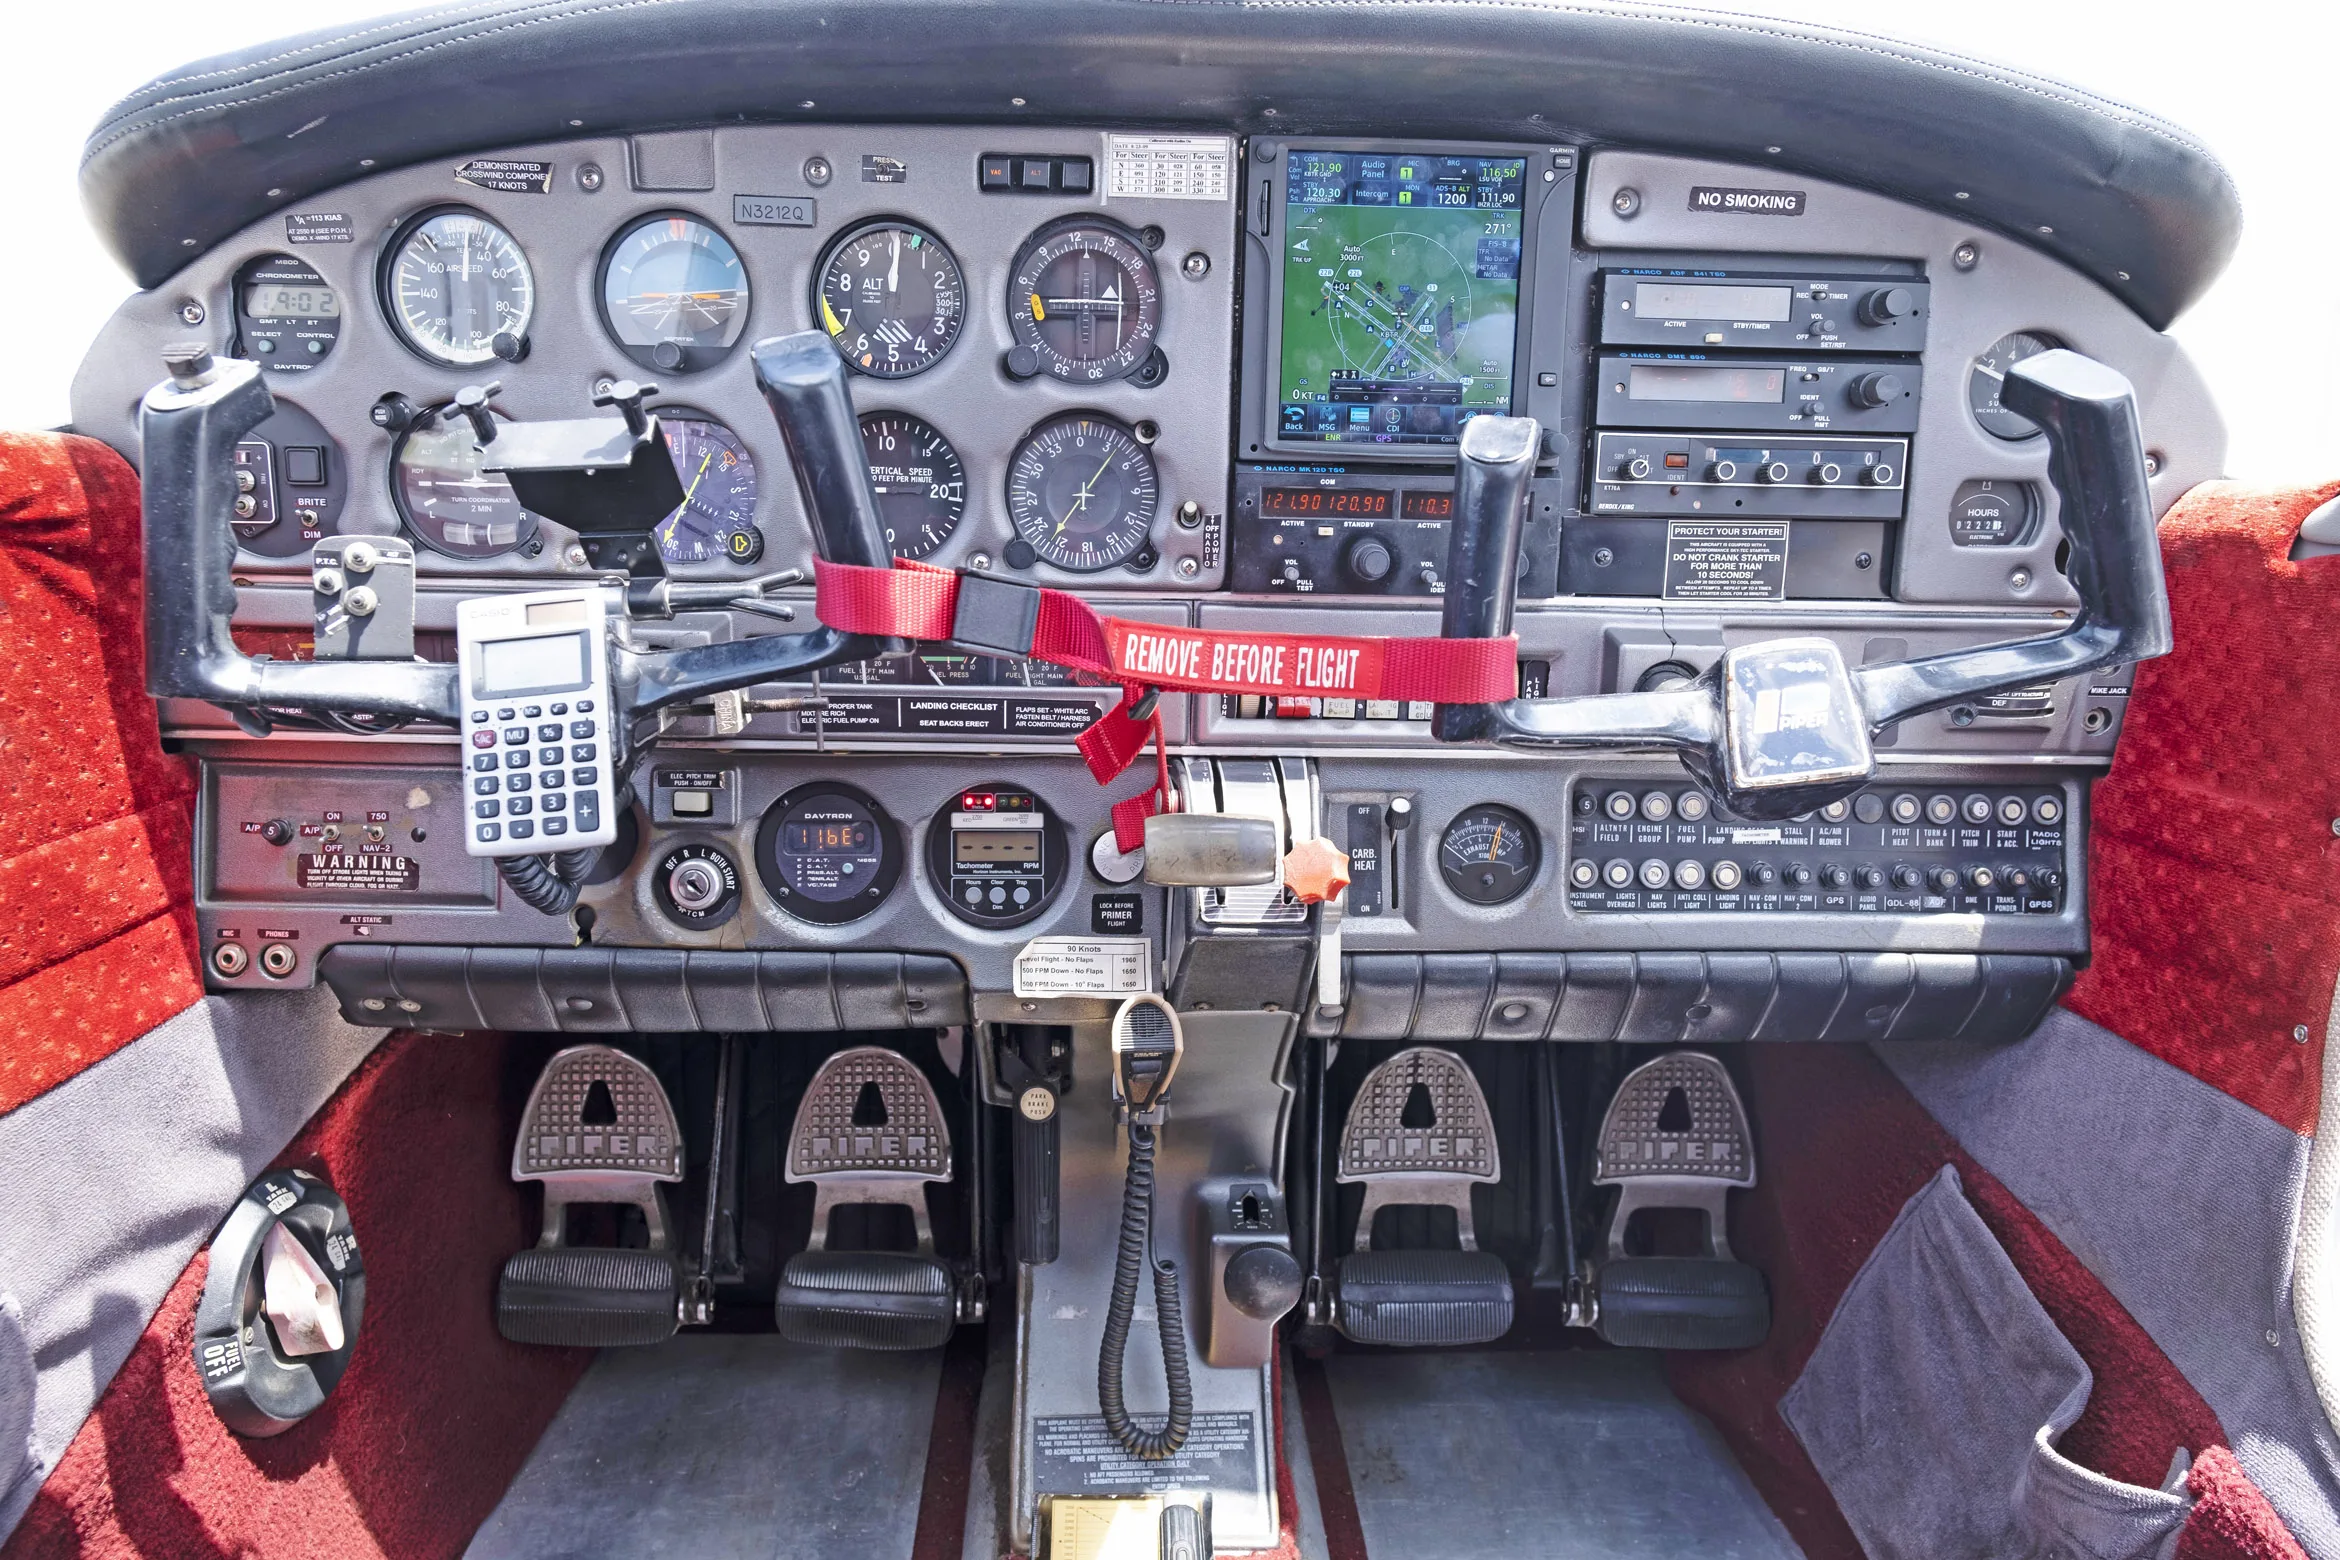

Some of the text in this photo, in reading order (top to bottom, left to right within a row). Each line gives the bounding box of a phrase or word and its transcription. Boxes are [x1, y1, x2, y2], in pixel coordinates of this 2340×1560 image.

[1115, 151, 1127, 160] For
[1130, 152, 1148, 160] Steer
[1154, 153, 1166, 161] For
[1169, 153, 1187, 161] Steer
[1192, 153, 1205, 161] For
[473, 162, 541, 172] DEMONSTRATED
[1308, 163, 1342, 173] 121.90
[1362, 160, 1386, 170] Audio
[456, 171, 504, 179] CROSSWIND
[1362, 169, 1384, 179] Panel
[1483, 168, 1516, 178] 116.50
[876, 174, 893, 182] TEST
[488, 181, 528, 190] 17 KNOTS
[1307, 188, 1341, 198] 120.30
[1356, 190, 1389, 198] Intercom
[1438, 194, 1467, 205] 1200
[1481, 193, 1515, 203] 111.90
[1698, 192, 1797, 210] NO SMOKING
[742, 204, 804, 222] N3212Q
[1344, 245, 1361, 253] Auto
[427, 263, 444, 273] 160
[446, 264, 483, 273] AIRSEED
[862, 278, 883, 289] ALT
[1733, 322, 1770, 330] STBY/TIMER
[1285, 422, 1303, 431] Back
[1318, 423, 1335, 431] MSG
[1350, 424, 1370, 432] Menu
[1387, 424, 1400, 432] CDI
[909, 467, 933, 477] SPEED
[298, 498, 327, 506] BRITE
[1968, 509, 1999, 517] HOURS
[304, 531, 321, 539] DIM
[1674, 527, 1783, 536] PROTECT YOUR STARTER!
[1673, 554, 1686, 562] DO
[1688, 554, 1706, 562] NOT
[1708, 554, 1739, 562] CRANK
[1738, 563, 1762, 571] THAN
[1709, 572, 1754, 580] SECONDS!
[1125, 634, 1360, 689] REMOVE BEFORE FLIGHT
[2108, 687, 2127, 695] JACK
[910, 702, 998, 711] LANDING CHECKLIST
[967, 720, 989, 728] ERECT
[1358, 807, 1370, 815] OFF
[1638, 825, 1662, 833] ENGINE
[1785, 827, 1803, 835] STALL
[1924, 829, 1941, 837] TURN
[1997, 830, 2017, 838] START
[1639, 835, 1661, 843] GROUP
[1819, 838, 1842, 846] BLOWER
[1893, 838, 1909, 846] HEAT
[1926, 838, 1944, 847] BANK
[1352, 849, 1377, 859] CARB.
[313, 854, 406, 870] WARNING
[710, 852, 727, 868] BOTH
[1354, 860, 1376, 871] HEAT
[2029, 900, 2053, 908] GPSS
[1102, 911, 1132, 920] PRIMER
[1078, 945, 1101, 953] Knots
[1077, 956, 1094, 964] Flaps
[540, 1135, 655, 1155] PIPER
[812, 1137, 927, 1156] PIPER
[1363, 1137, 1474, 1157] PIPER
[1620, 1141, 1731, 1161] PIPER
[204, 1345, 228, 1377] OFF
[224, 1342, 241, 1372] FUEL
